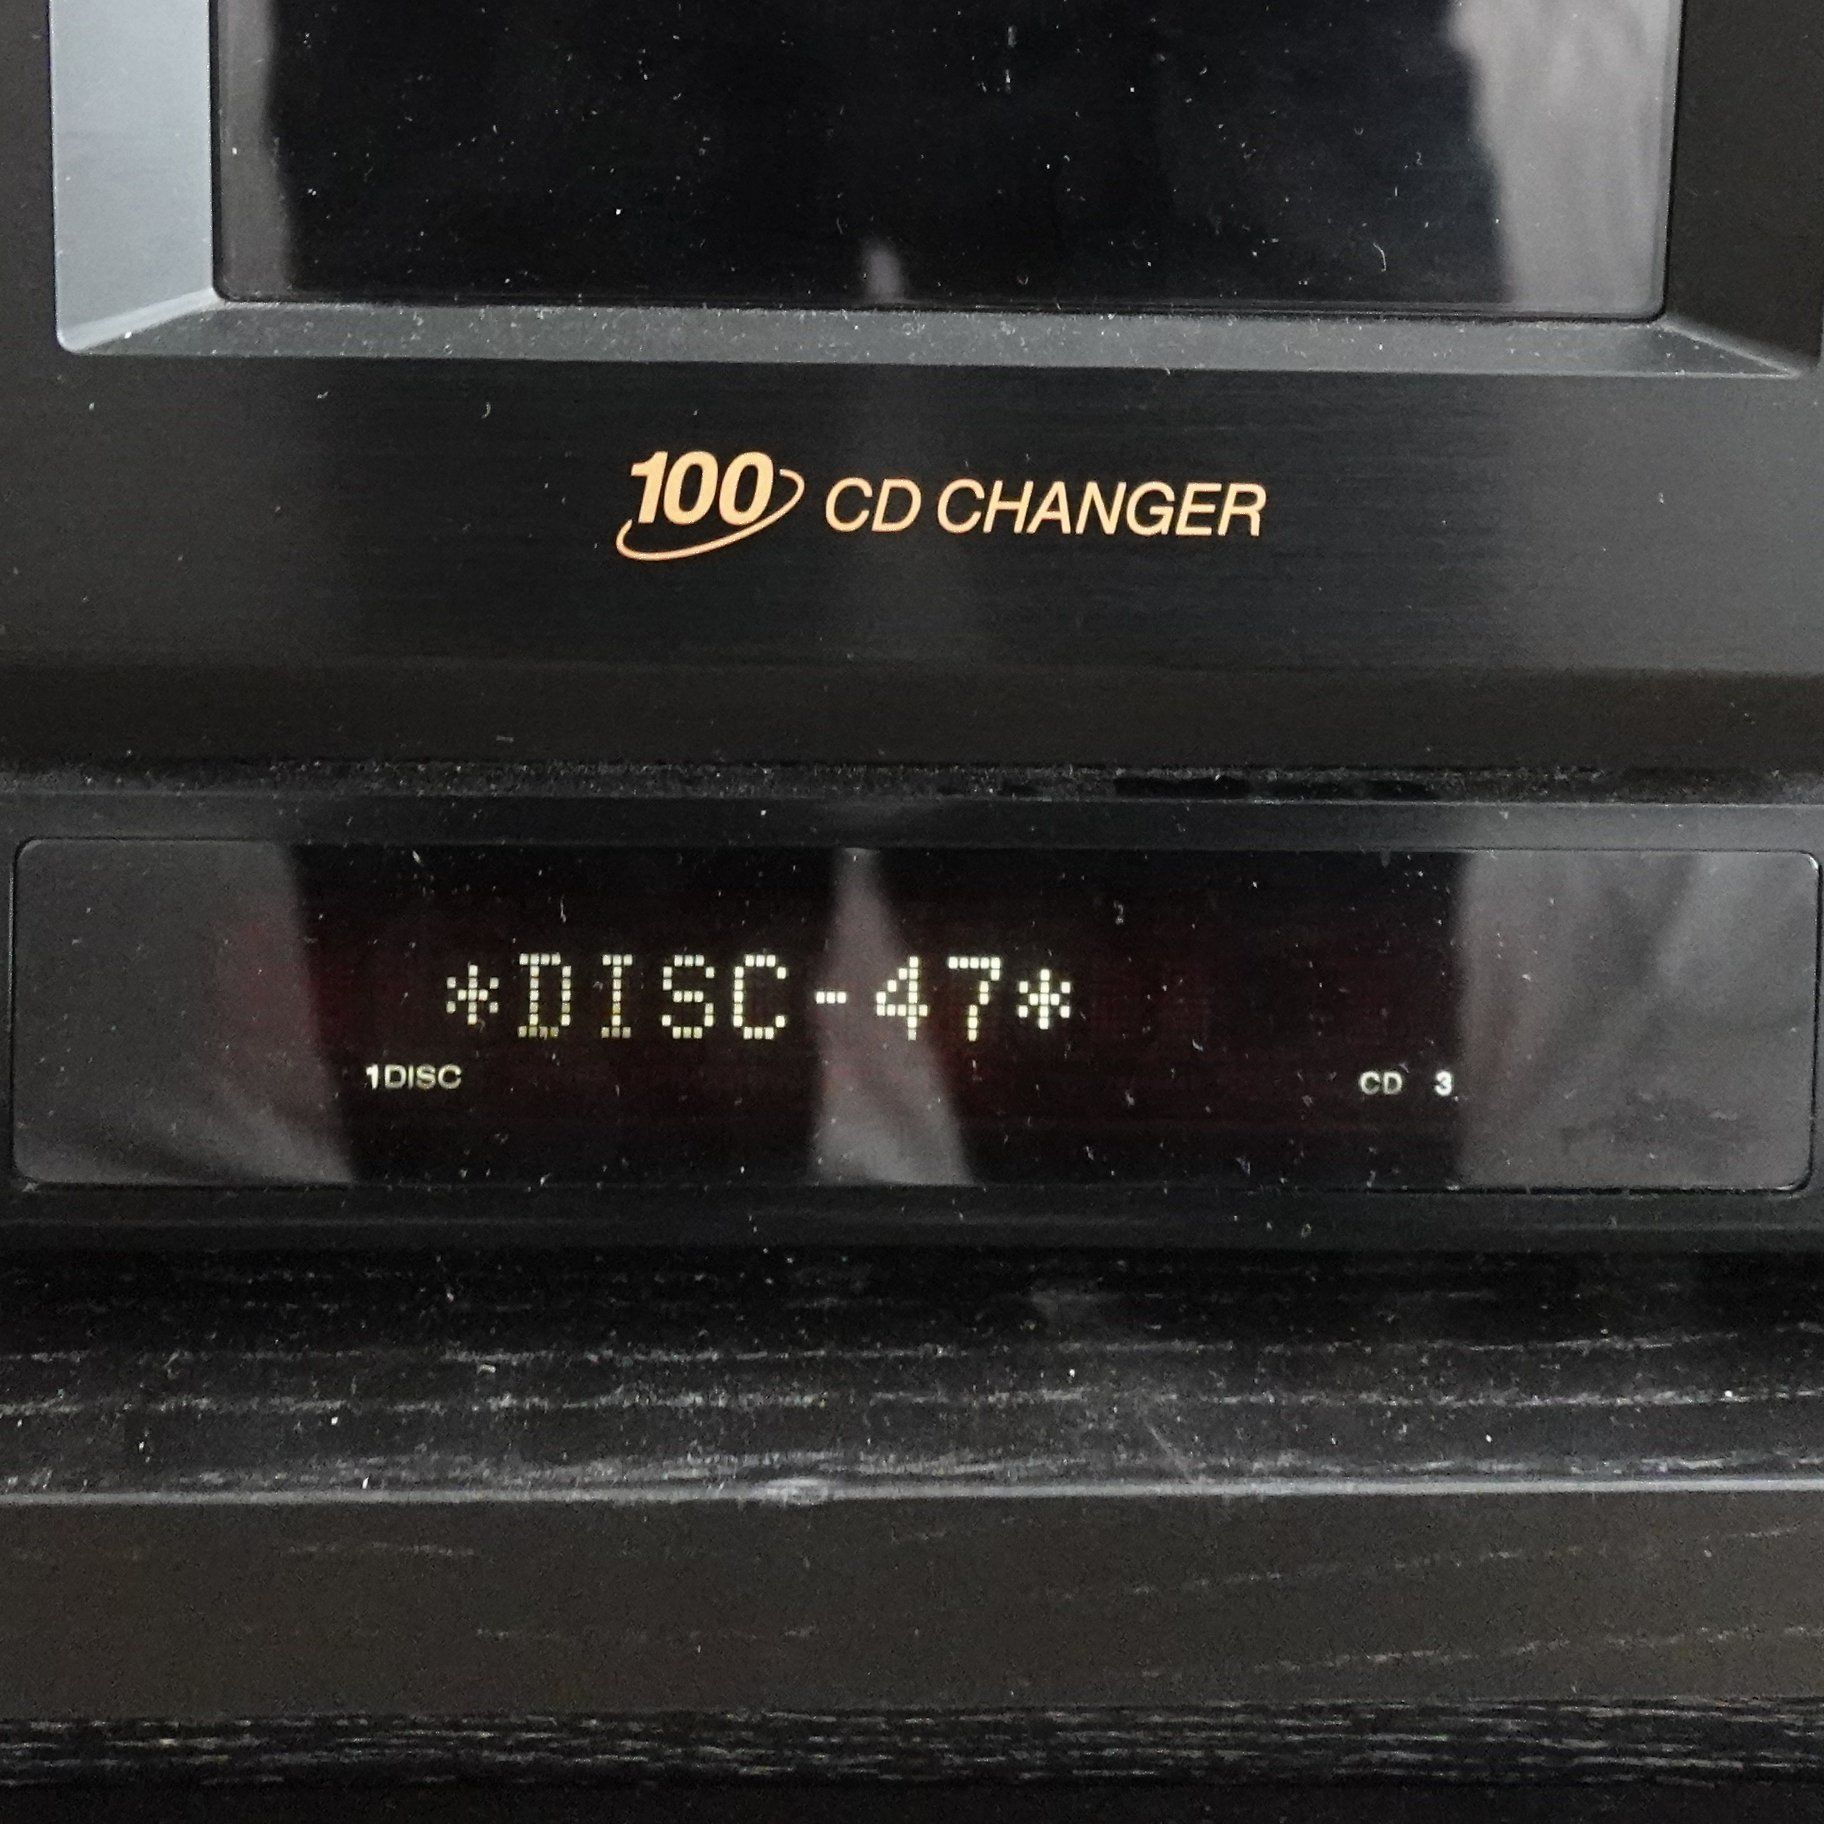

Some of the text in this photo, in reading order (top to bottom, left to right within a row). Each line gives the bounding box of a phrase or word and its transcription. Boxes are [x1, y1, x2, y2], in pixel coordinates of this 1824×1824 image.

[630, 452, 1266, 537] 100 CD CHANGER
[1359, 1070, 1453, 1095] CD 3
